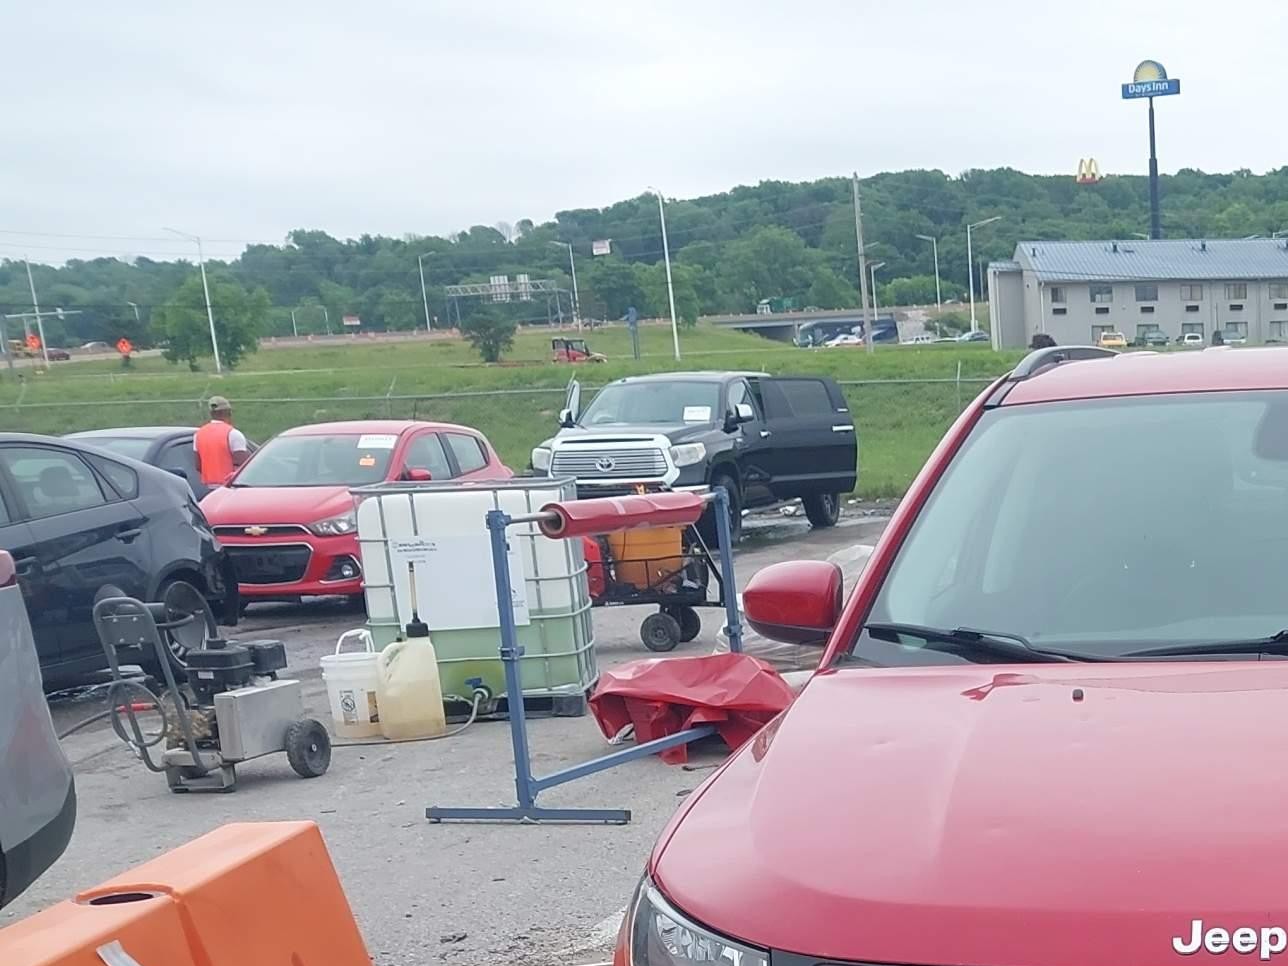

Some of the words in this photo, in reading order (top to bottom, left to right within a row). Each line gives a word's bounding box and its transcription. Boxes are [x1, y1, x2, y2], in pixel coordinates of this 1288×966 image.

[1128, 83, 1151, 93] Days
[1152, 81, 1169, 91] Inn
[1172, 919, 1287, 960] Jeep
